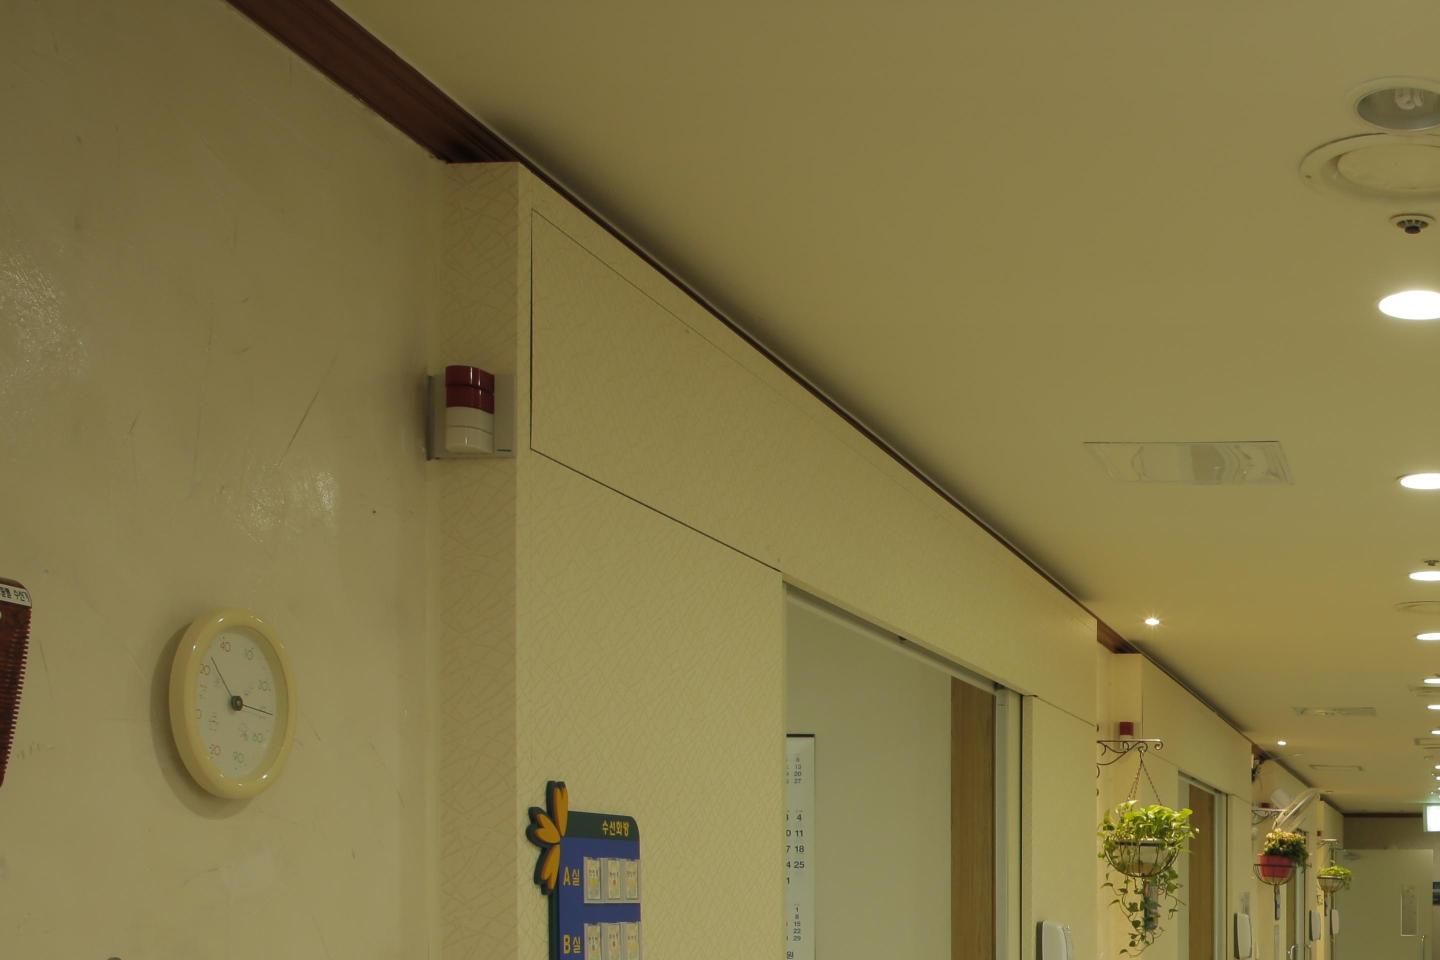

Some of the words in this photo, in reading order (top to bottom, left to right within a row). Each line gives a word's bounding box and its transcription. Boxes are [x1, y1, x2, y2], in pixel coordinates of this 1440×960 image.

[602, 819, 630, 837] 수선화방
[795, 829, 803, 837] 11
[795, 845, 805, 853] 18
[563, 866, 581, 887] A실
[563, 934, 582, 954] B실
